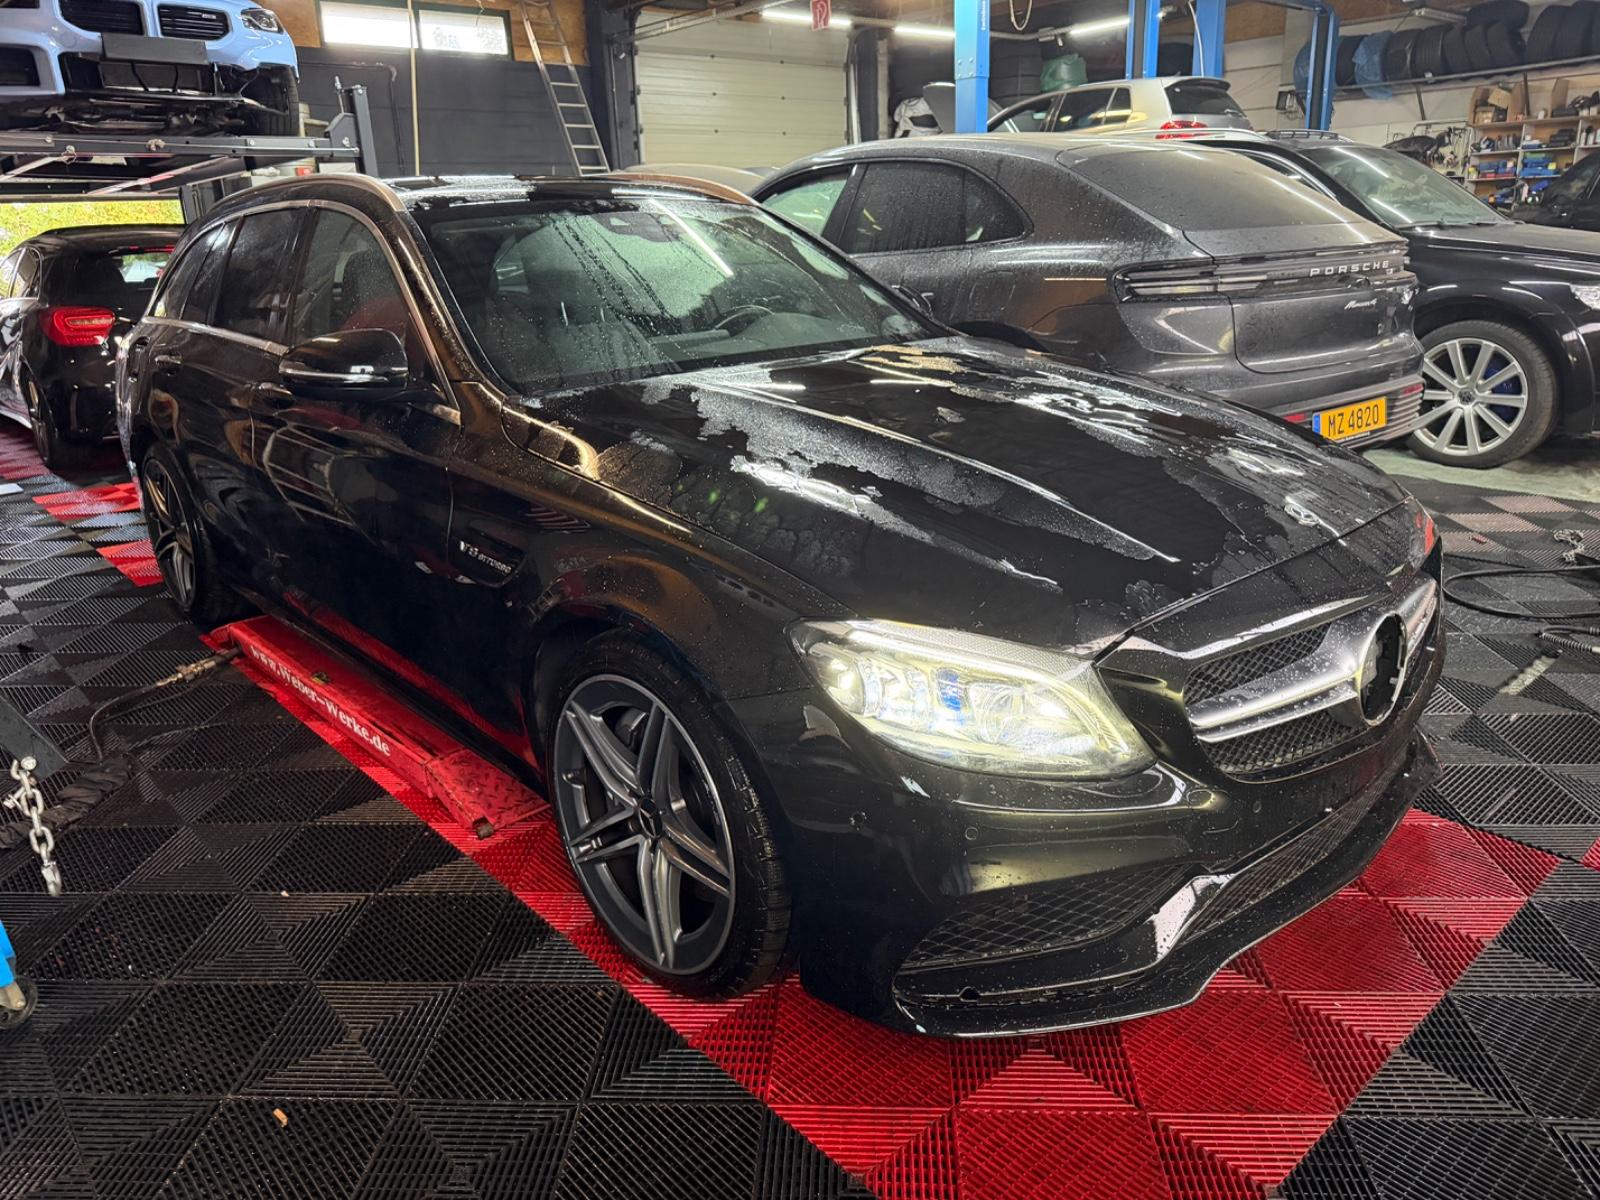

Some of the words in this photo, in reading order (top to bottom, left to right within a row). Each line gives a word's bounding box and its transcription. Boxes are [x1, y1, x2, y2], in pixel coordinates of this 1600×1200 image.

[1309, 260, 1390, 277] PORSCHE
[1328, 412, 1345, 437] MZ
[1348, 404, 1379, 431] 4820
[250, 644, 391, 757] www.Weber-Werke.de
